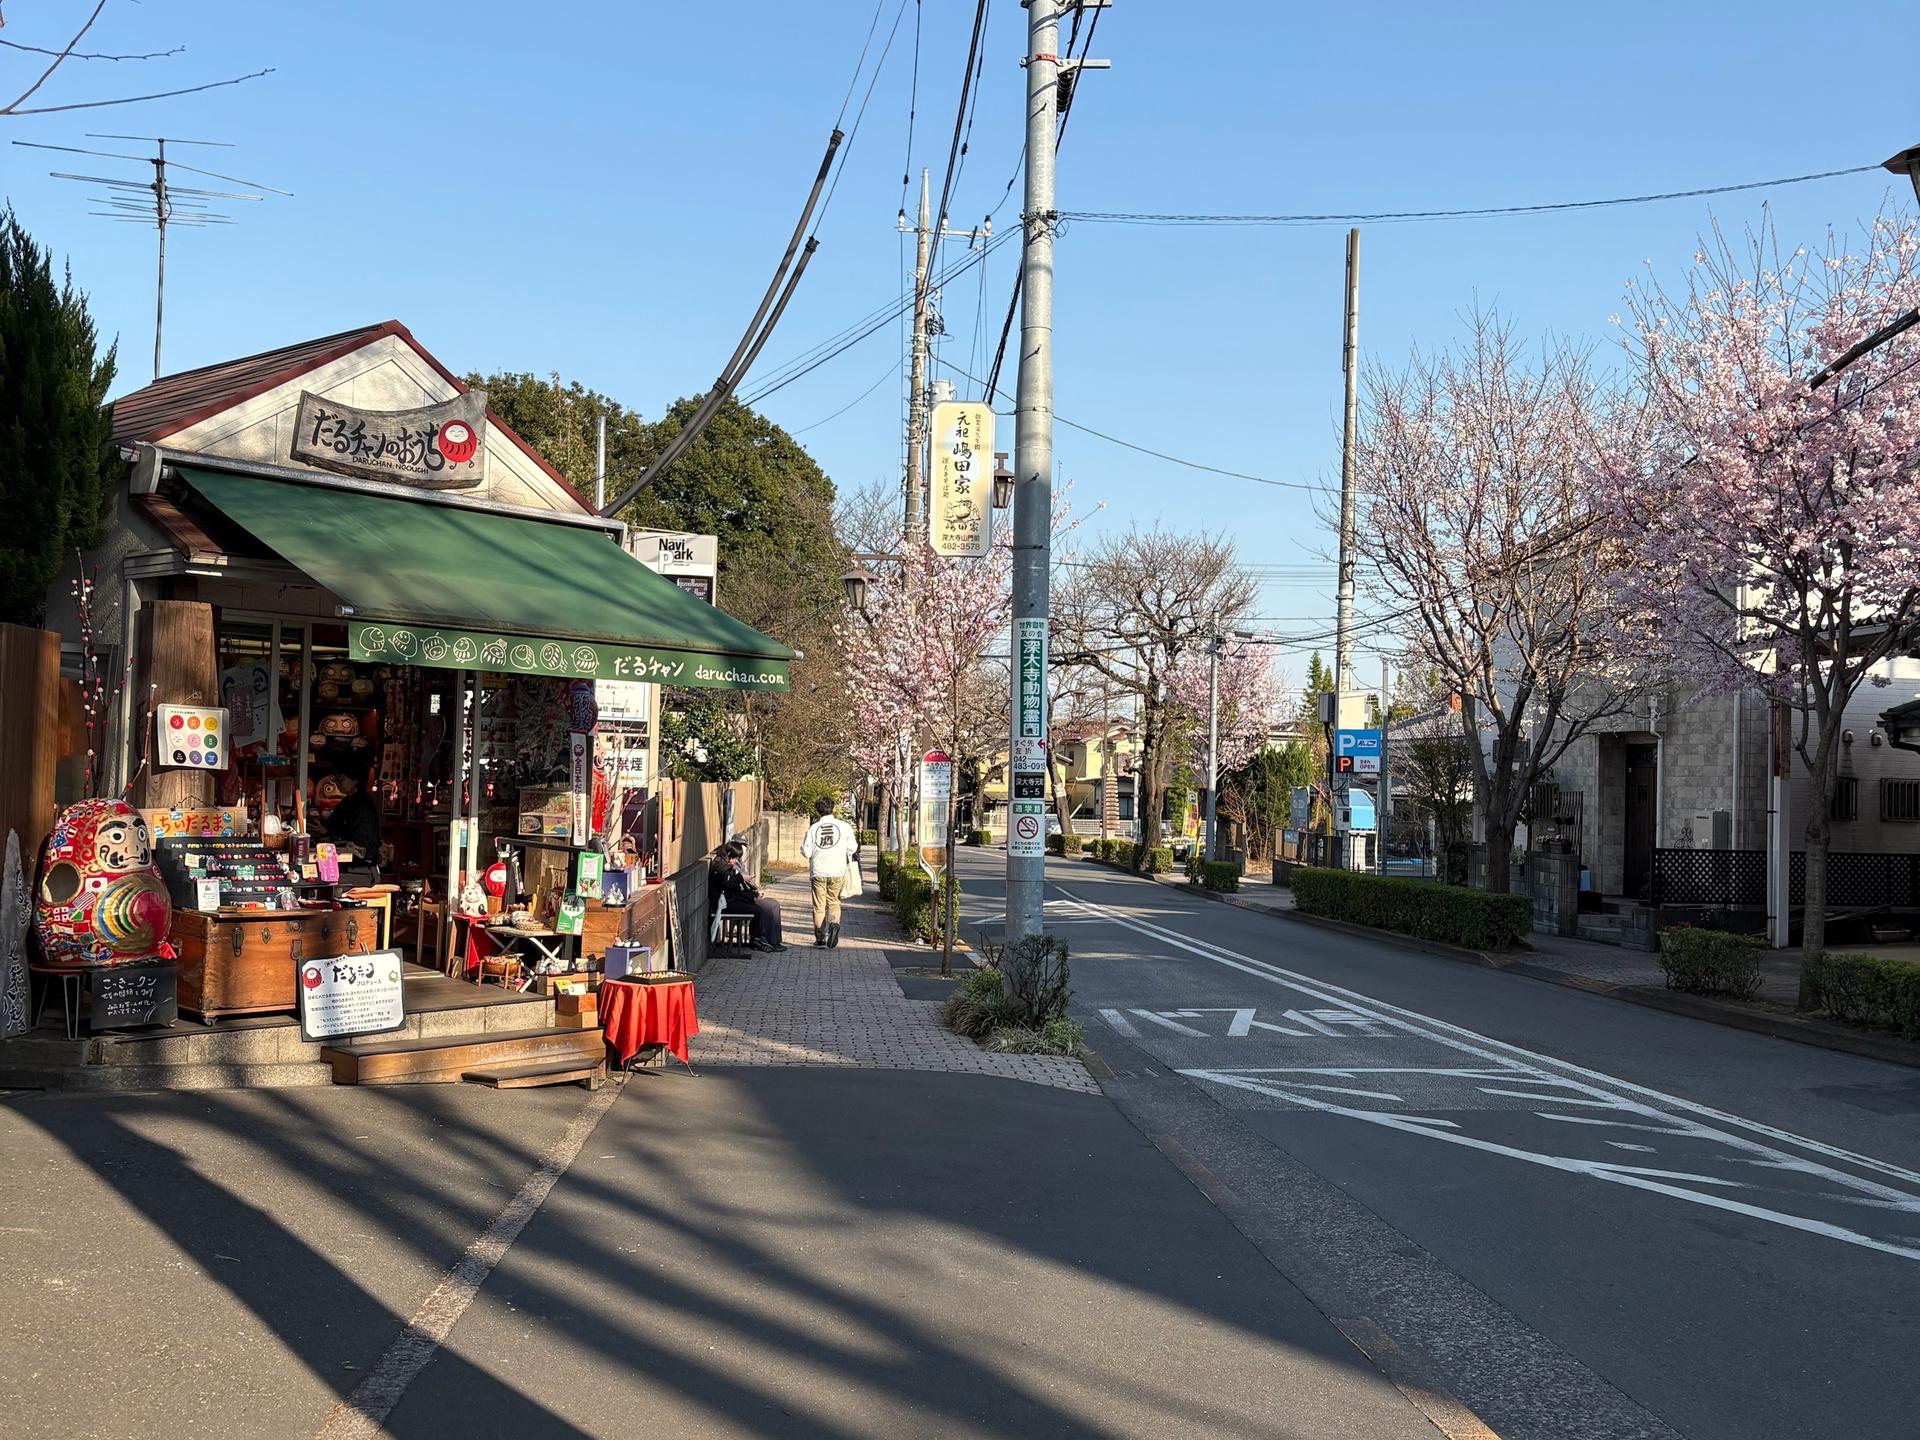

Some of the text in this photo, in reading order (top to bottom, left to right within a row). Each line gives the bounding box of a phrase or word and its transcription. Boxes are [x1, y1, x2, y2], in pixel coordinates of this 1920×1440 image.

[312, 408, 446, 471] だるチャンのおうち
[659, 538, 685, 551] Navi
[942, 543, 980, 551] 482-3578
[1021, 630, 1043, 638] 友の会
[614, 655, 685, 678] だるチャン
